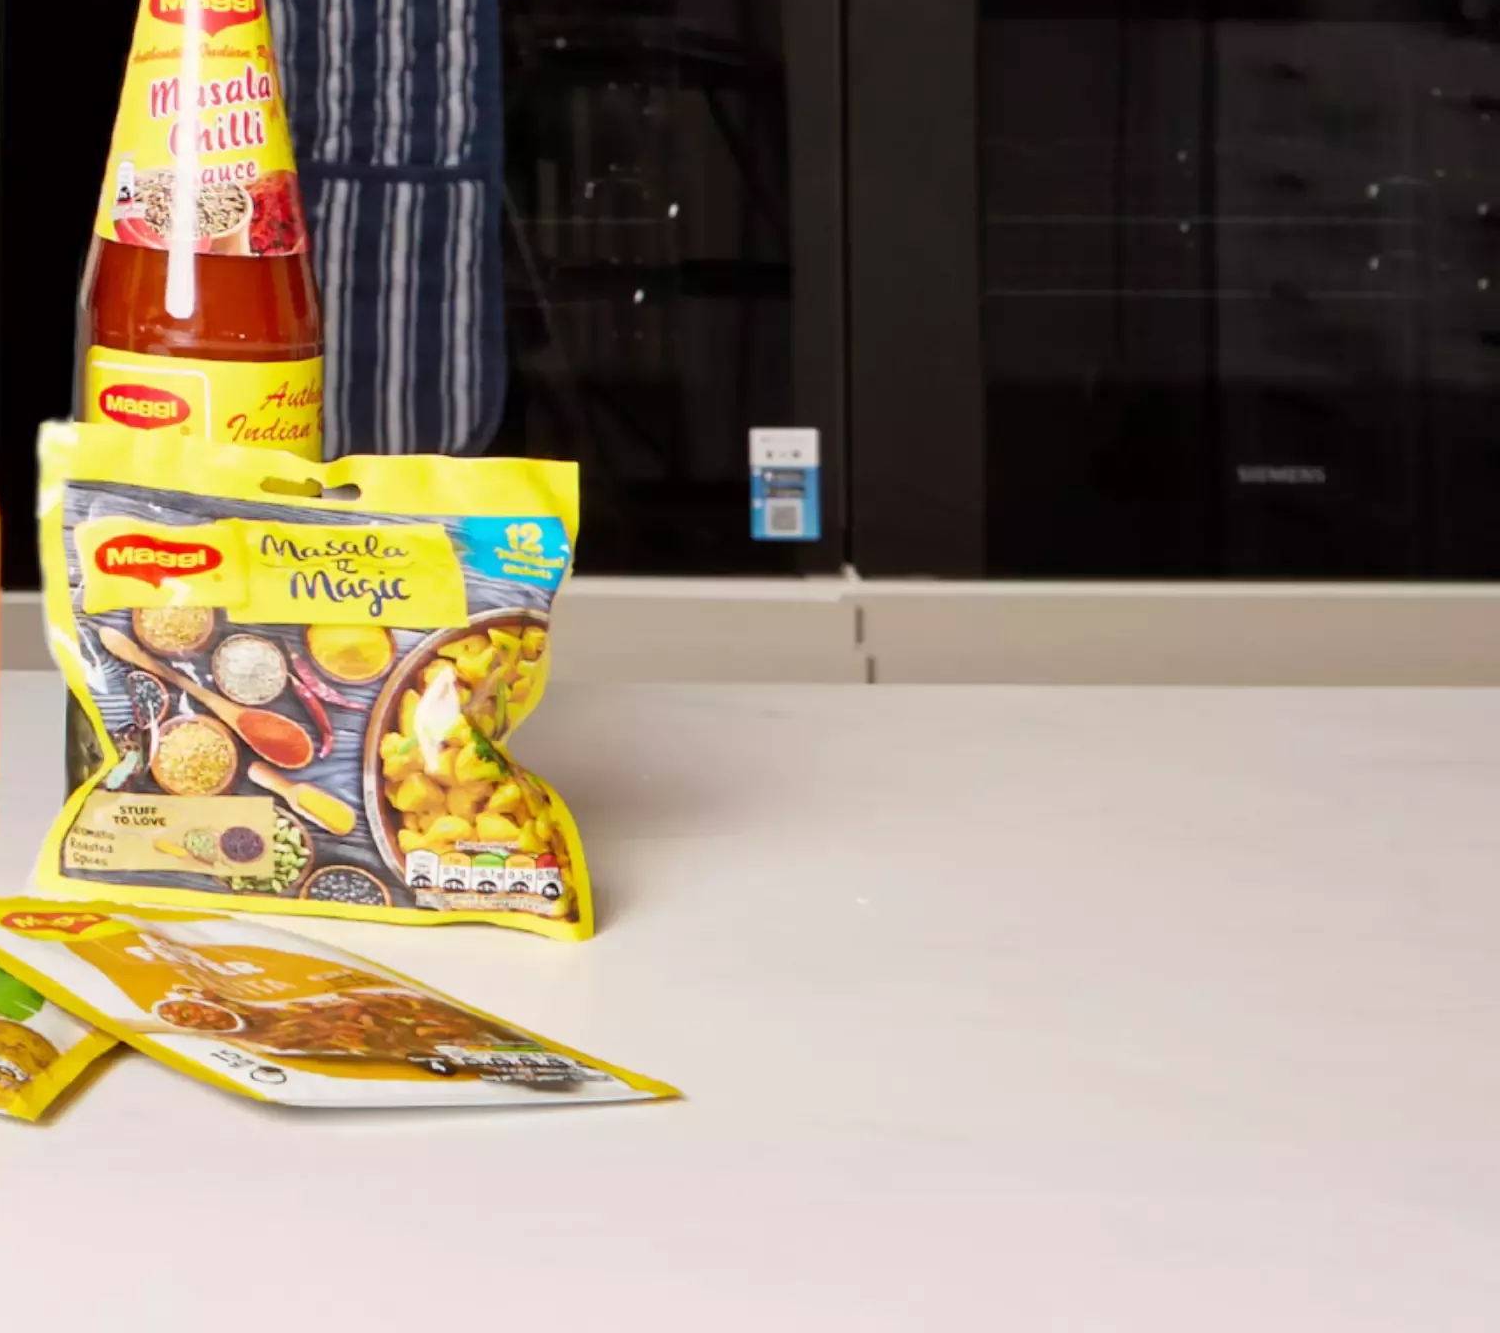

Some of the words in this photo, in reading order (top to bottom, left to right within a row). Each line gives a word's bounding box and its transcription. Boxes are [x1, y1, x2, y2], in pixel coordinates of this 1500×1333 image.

[170, 110, 265, 156] Cilli
[196, 160, 257, 185] auce
[105, 394, 178, 419] Maggi
[226, 413, 310, 442] Indian
[261, 534, 406, 560] Masala
[505, 522, 544, 555] 12
[106, 546, 206, 568] Maggi
[289, 569, 411, 618] Magic
